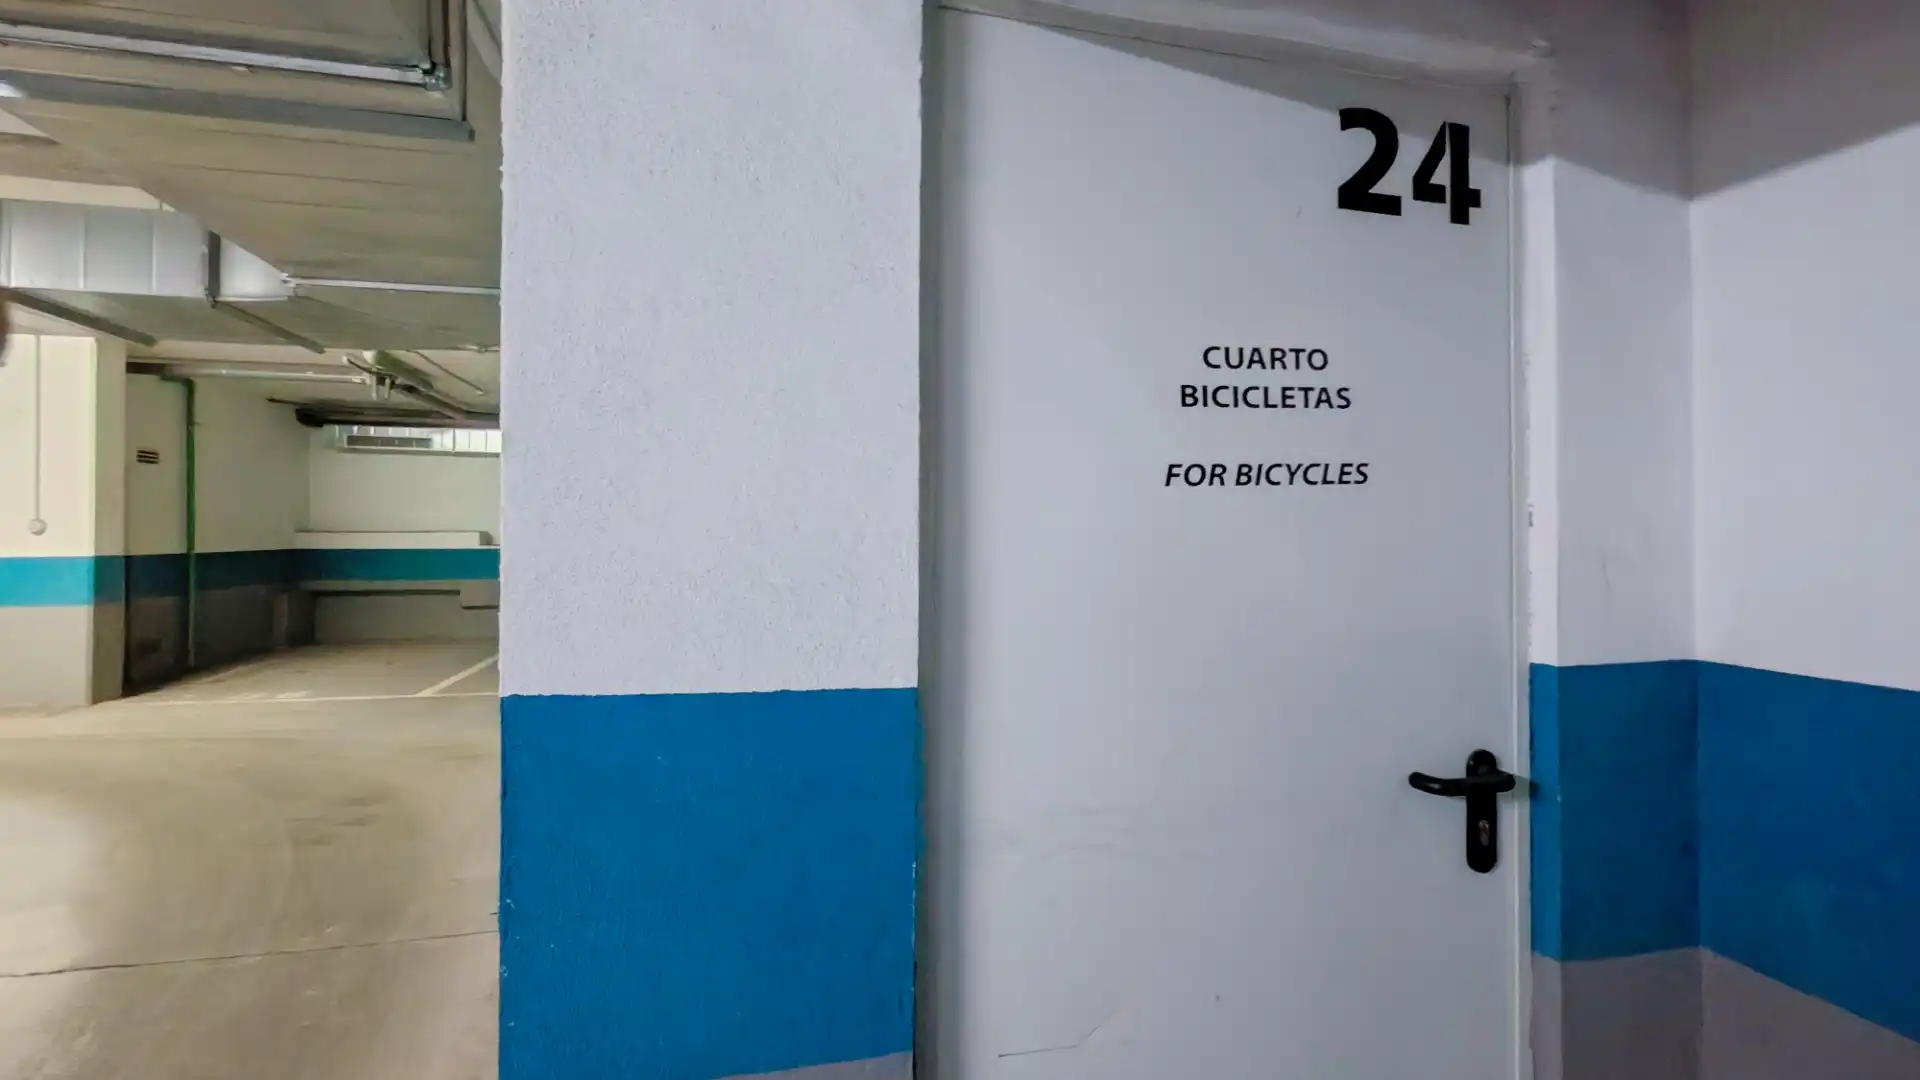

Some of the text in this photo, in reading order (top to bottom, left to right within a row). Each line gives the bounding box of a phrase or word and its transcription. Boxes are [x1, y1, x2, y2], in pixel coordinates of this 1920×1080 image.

[1338, 107, 1482, 225] 24
[1202, 346, 1329, 371] CUARTO
[1180, 385, 1352, 409] BICICLETAS
[1165, 462, 1369, 487] FOR BICYCLES
